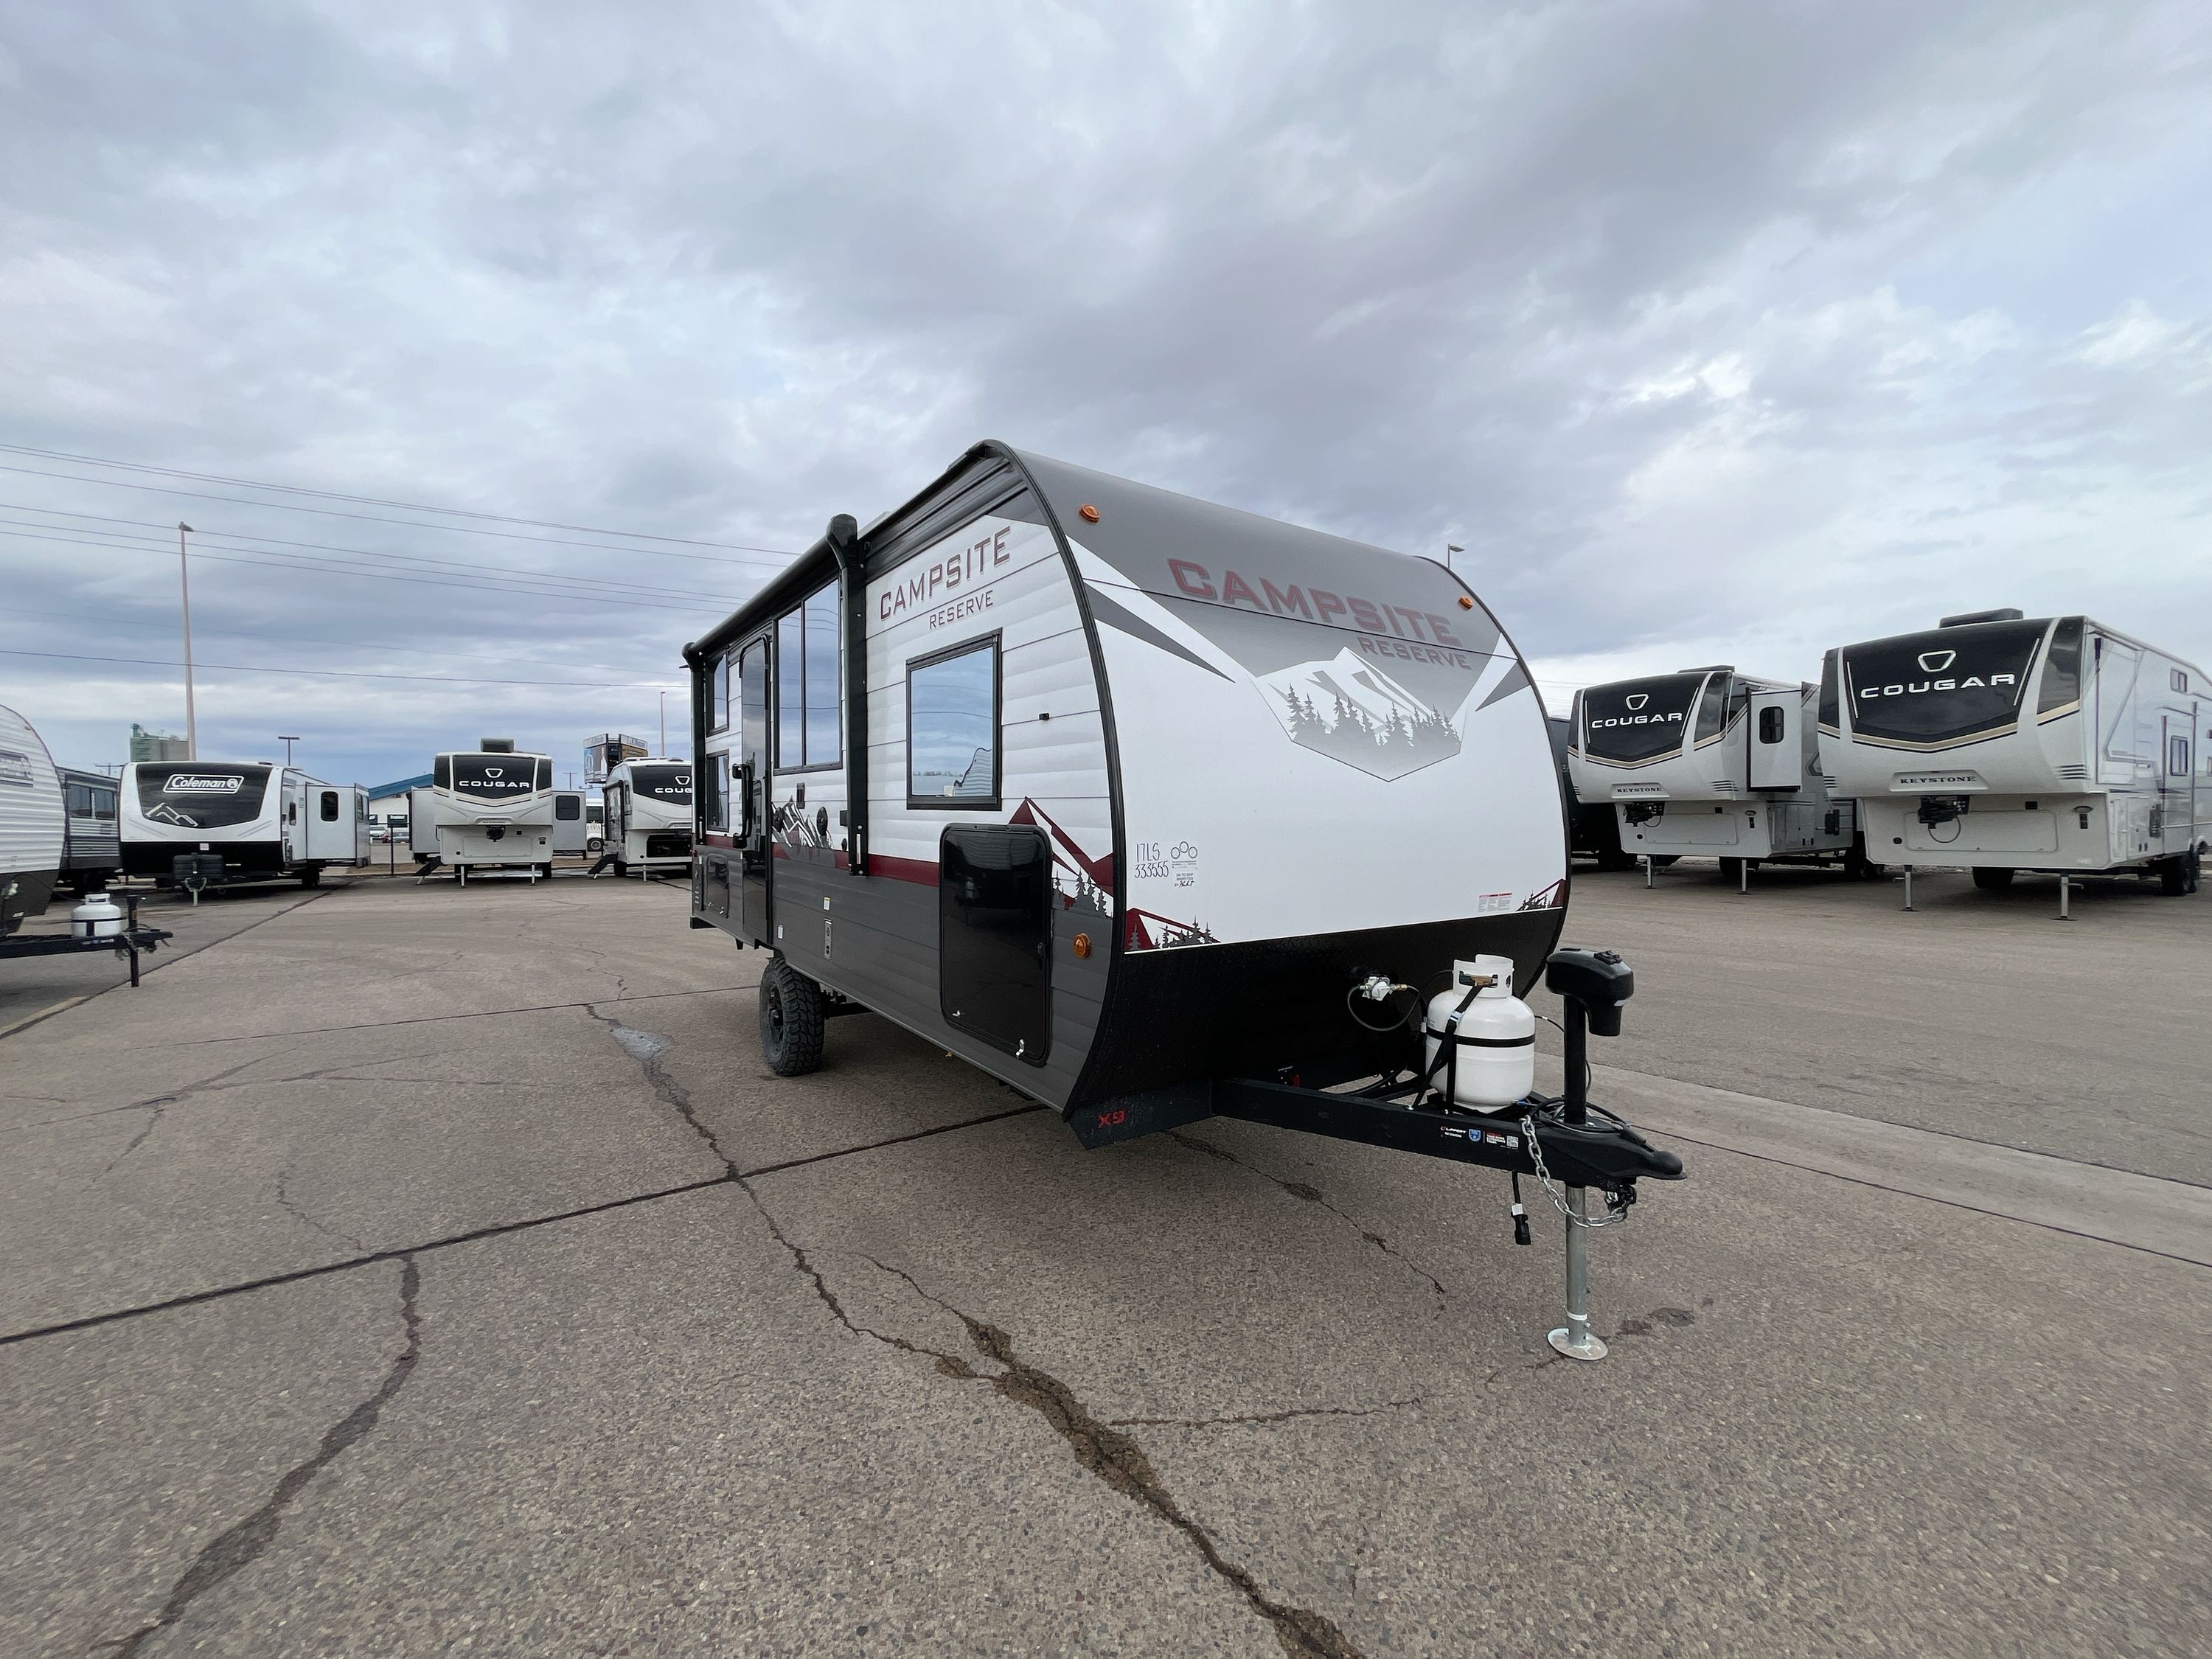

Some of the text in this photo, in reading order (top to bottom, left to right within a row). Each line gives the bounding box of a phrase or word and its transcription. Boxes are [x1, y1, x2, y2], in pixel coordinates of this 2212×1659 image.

[880, 526, 1010, 620] CAMPSITE
[929, 589, 994, 630] RESERVE
[1166, 557, 1462, 647] CAMPSITE
[1357, 636, 1472, 670] RESERVE
[1860, 674, 2015, 699] COUGAR
[1591, 712, 1683, 728] COUGAR
[171, 776, 226, 788] Coleman
[1900, 776, 1977, 785] KEYSTONE
[1134, 860, 1169, 879] 333555
